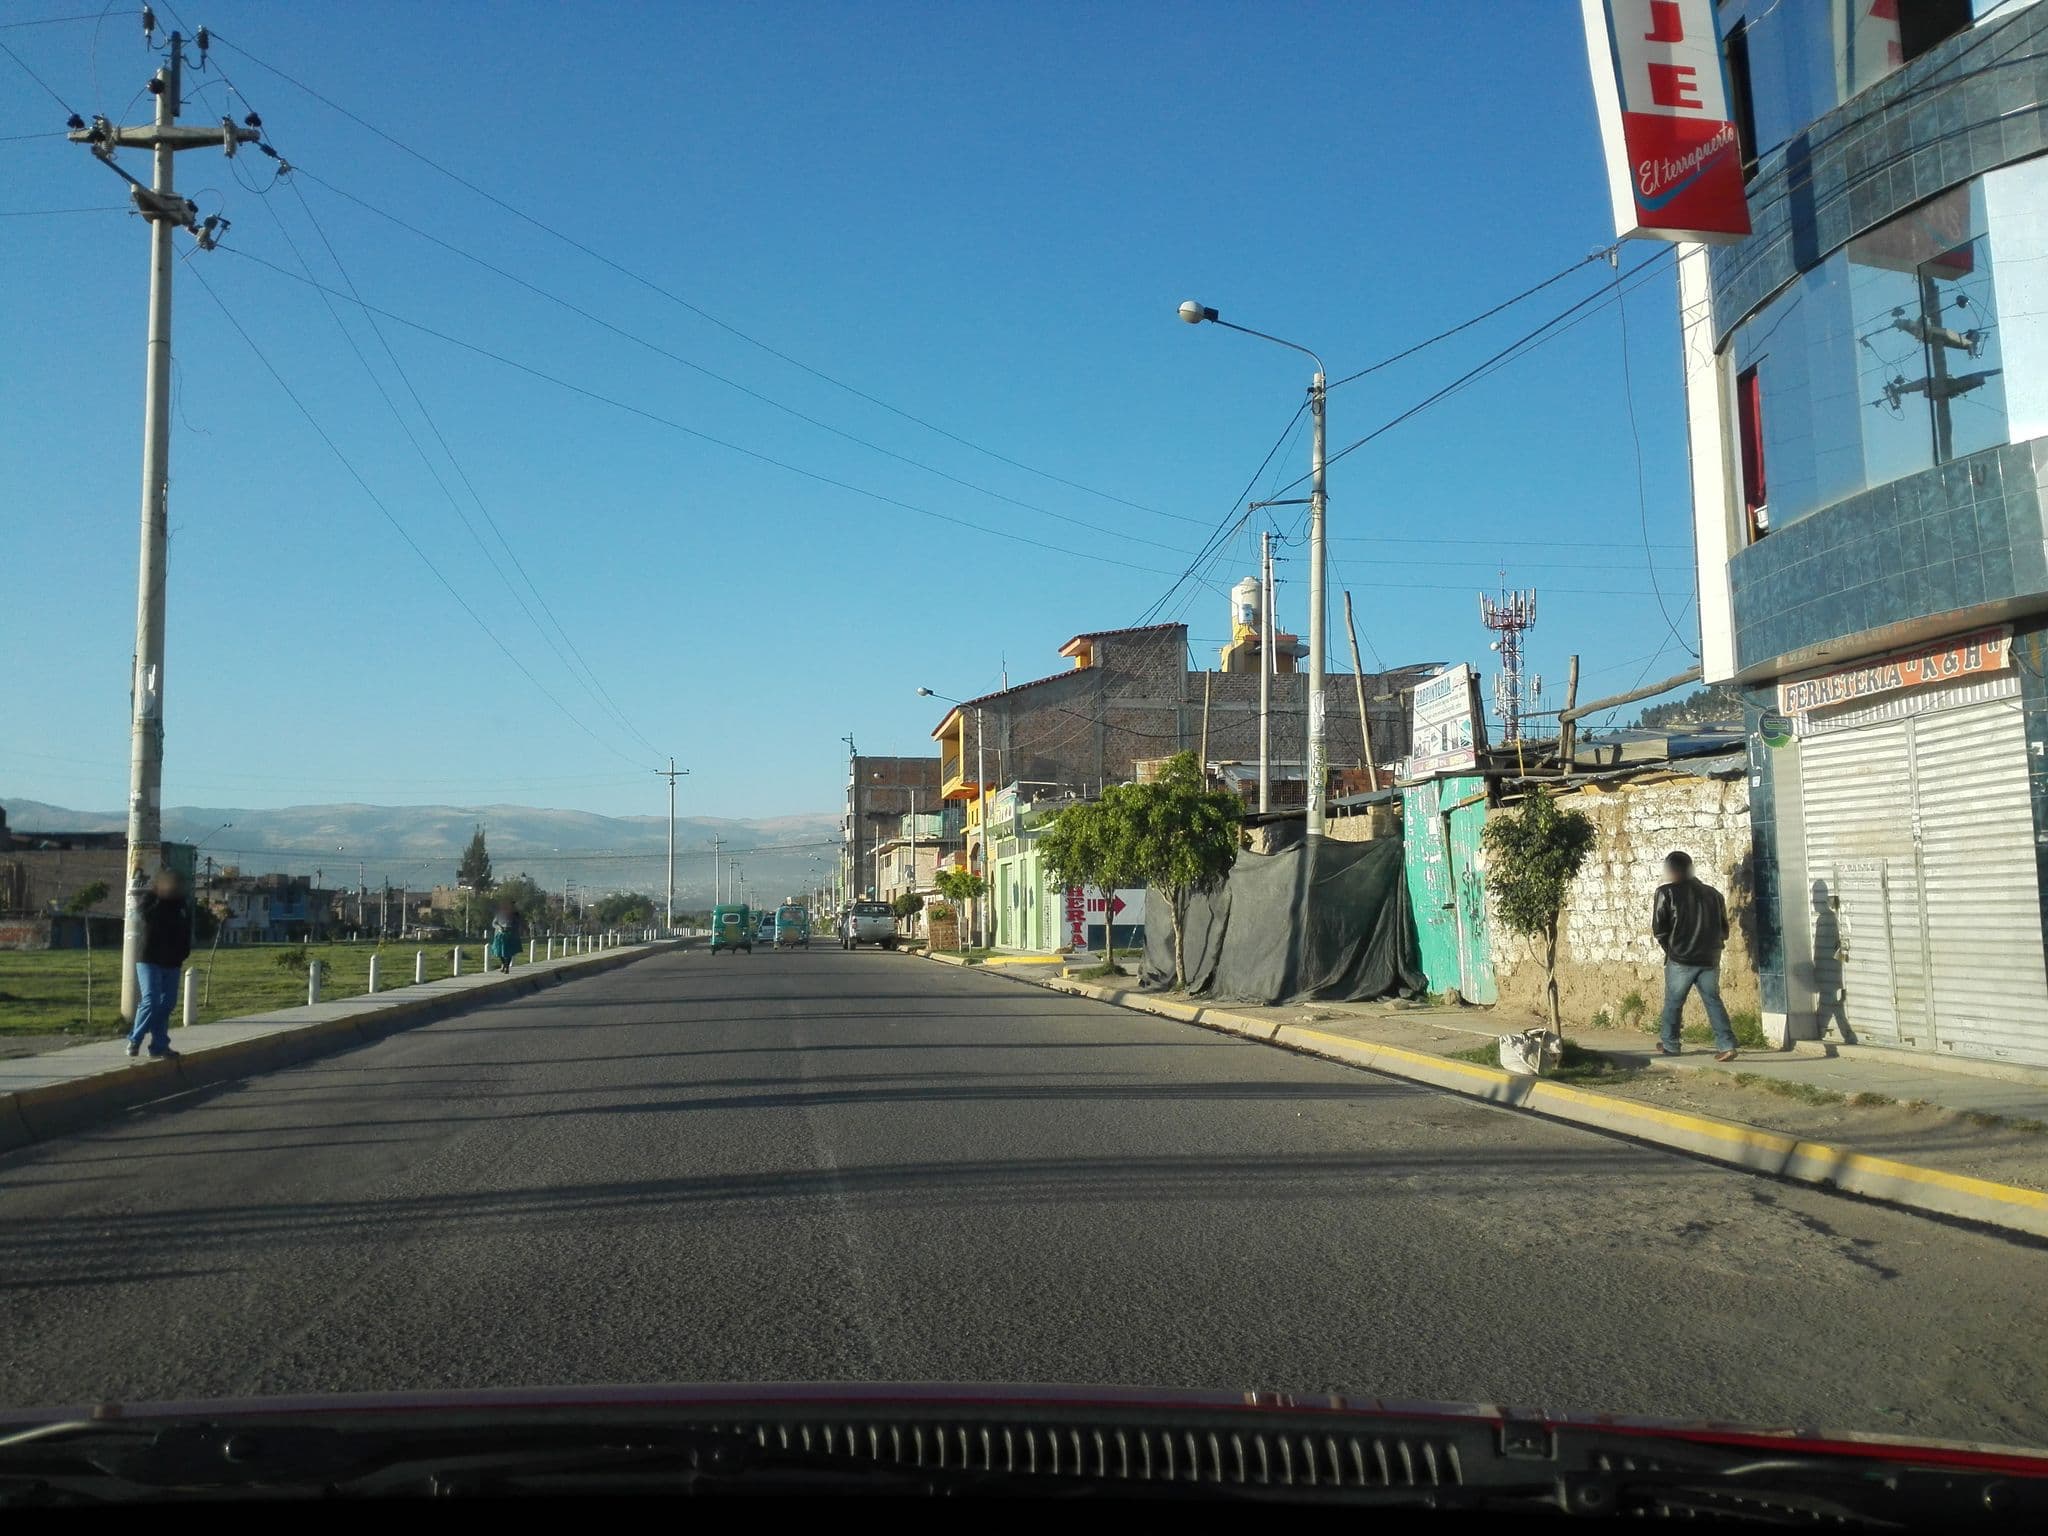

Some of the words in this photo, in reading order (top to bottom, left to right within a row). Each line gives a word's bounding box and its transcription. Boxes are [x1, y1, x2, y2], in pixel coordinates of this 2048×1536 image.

[1639, 160, 1661, 195] El
[1662, 122, 1735, 184] terrapuerto
[1785, 660, 1904, 714] FERRETERIA
